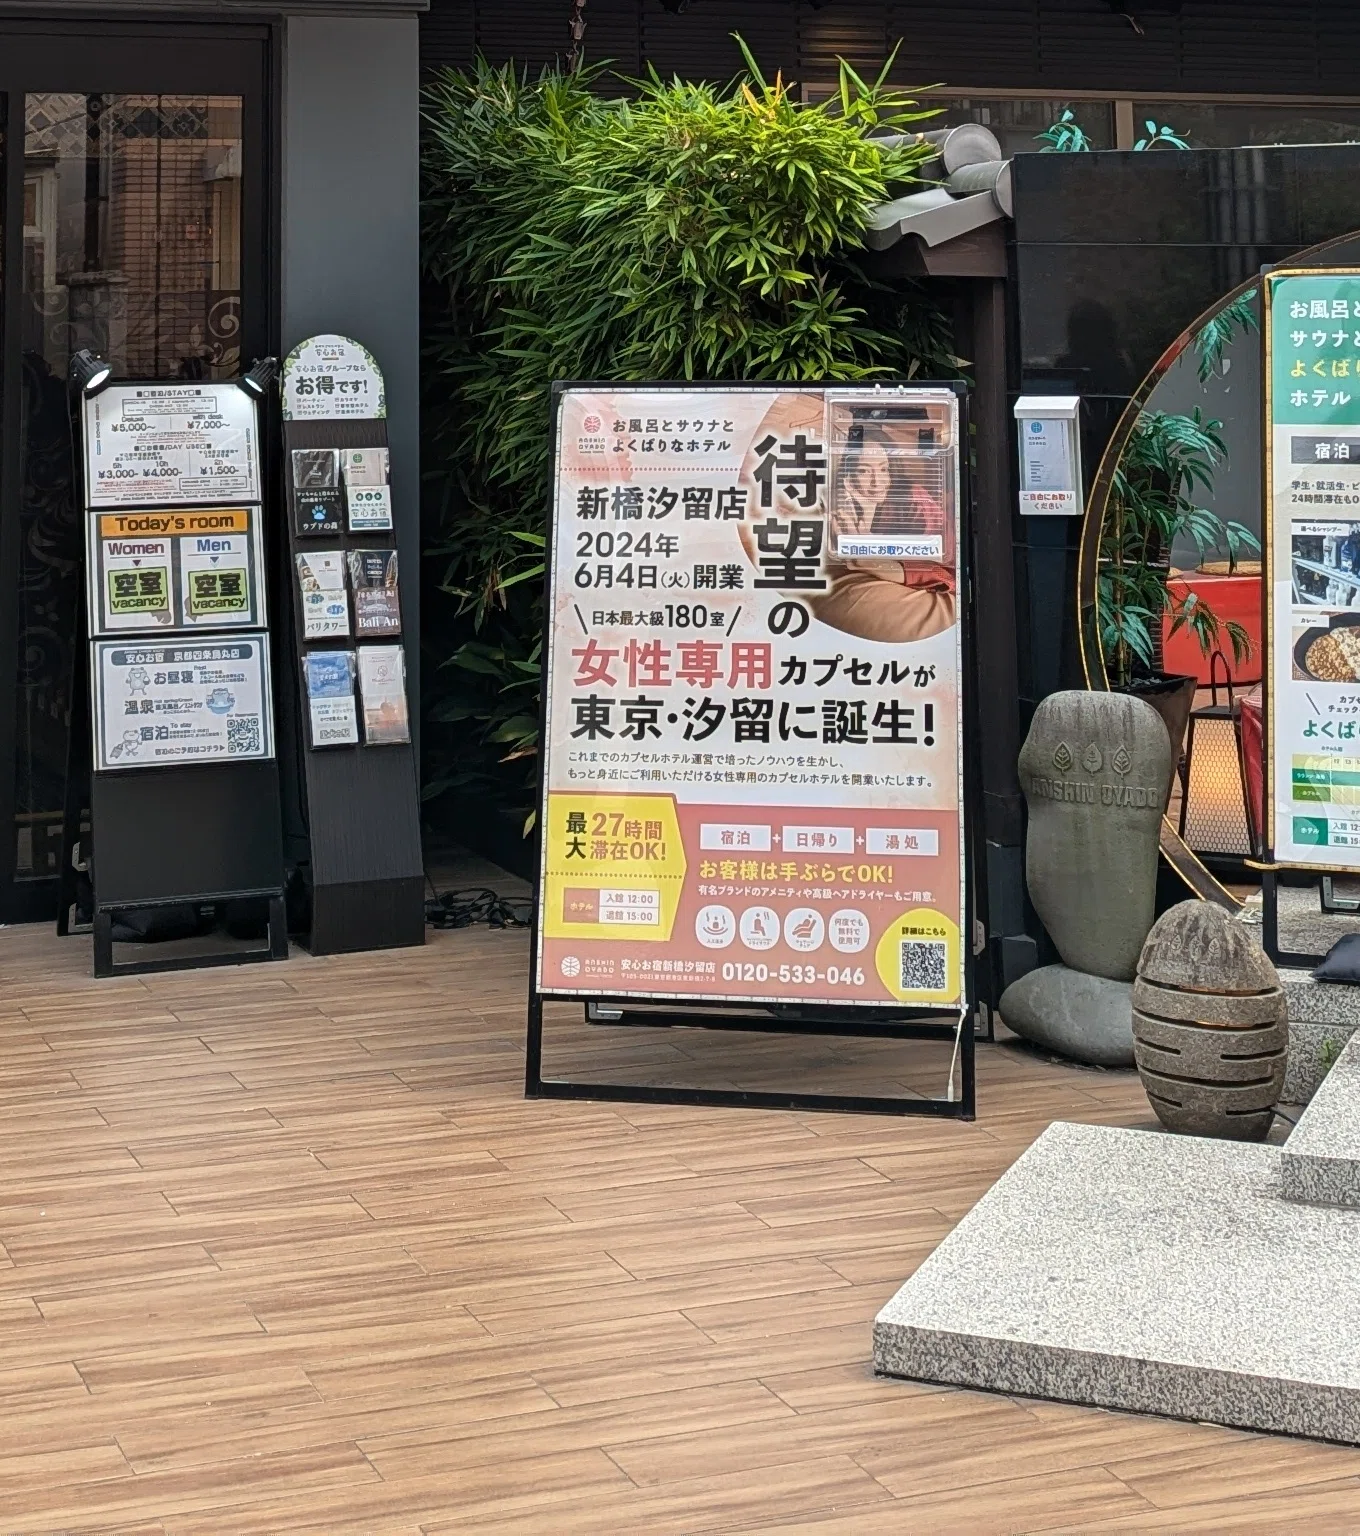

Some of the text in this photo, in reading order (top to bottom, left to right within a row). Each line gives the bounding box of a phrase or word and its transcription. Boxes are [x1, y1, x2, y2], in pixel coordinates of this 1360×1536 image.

[296, 376, 368, 395] お得です!
[1290, 390, 1351, 406] ホテル
[613, 419, 734, 432] お風呂とサウナと
[613, 439, 731, 452] よくばりなホテル
[1315, 443, 1350, 459] 宿泊
[576, 486, 747, 521] 新橋汐留店
[115, 516, 234, 531] Today's room
[108, 540, 231, 555] Women Men
[576, 532, 679, 558] 2024年
[841, 545, 939, 556] ご自由にお取りください
[115, 572, 242, 598] 空室 空室
[112, 596, 246, 609] vacancy vacancy
[359, 617, 399, 627] Bali An
[592, 605, 725, 628] 日本最大級180室
[307, 622, 347, 631] バリタワー
[154, 671, 193, 684] お昼寝
[125, 699, 154, 714] 温泉
[140, 726, 169, 741] 宿泊
[1031, 777, 1158, 808] ANSHIN OYADO
[592, 813, 663, 840] 27時間
[721, 830, 919, 850] 宿泊 日帰り 湯処
[699, 860, 893, 884] お客様は手ぶらでOK!
[628, 894, 653, 904] 12:00
[627, 912, 653, 921] 15:00
[834, 918, 863, 927] 何度でも
[838, 927, 860, 936] 無料で
[902, 927, 946, 936] 詳細はこちら
[838, 936, 860, 945] 使用可
[621, 959, 716, 974] 安心お宿新橋汐留店
[722, 962, 865, 986] 0120-533-046
